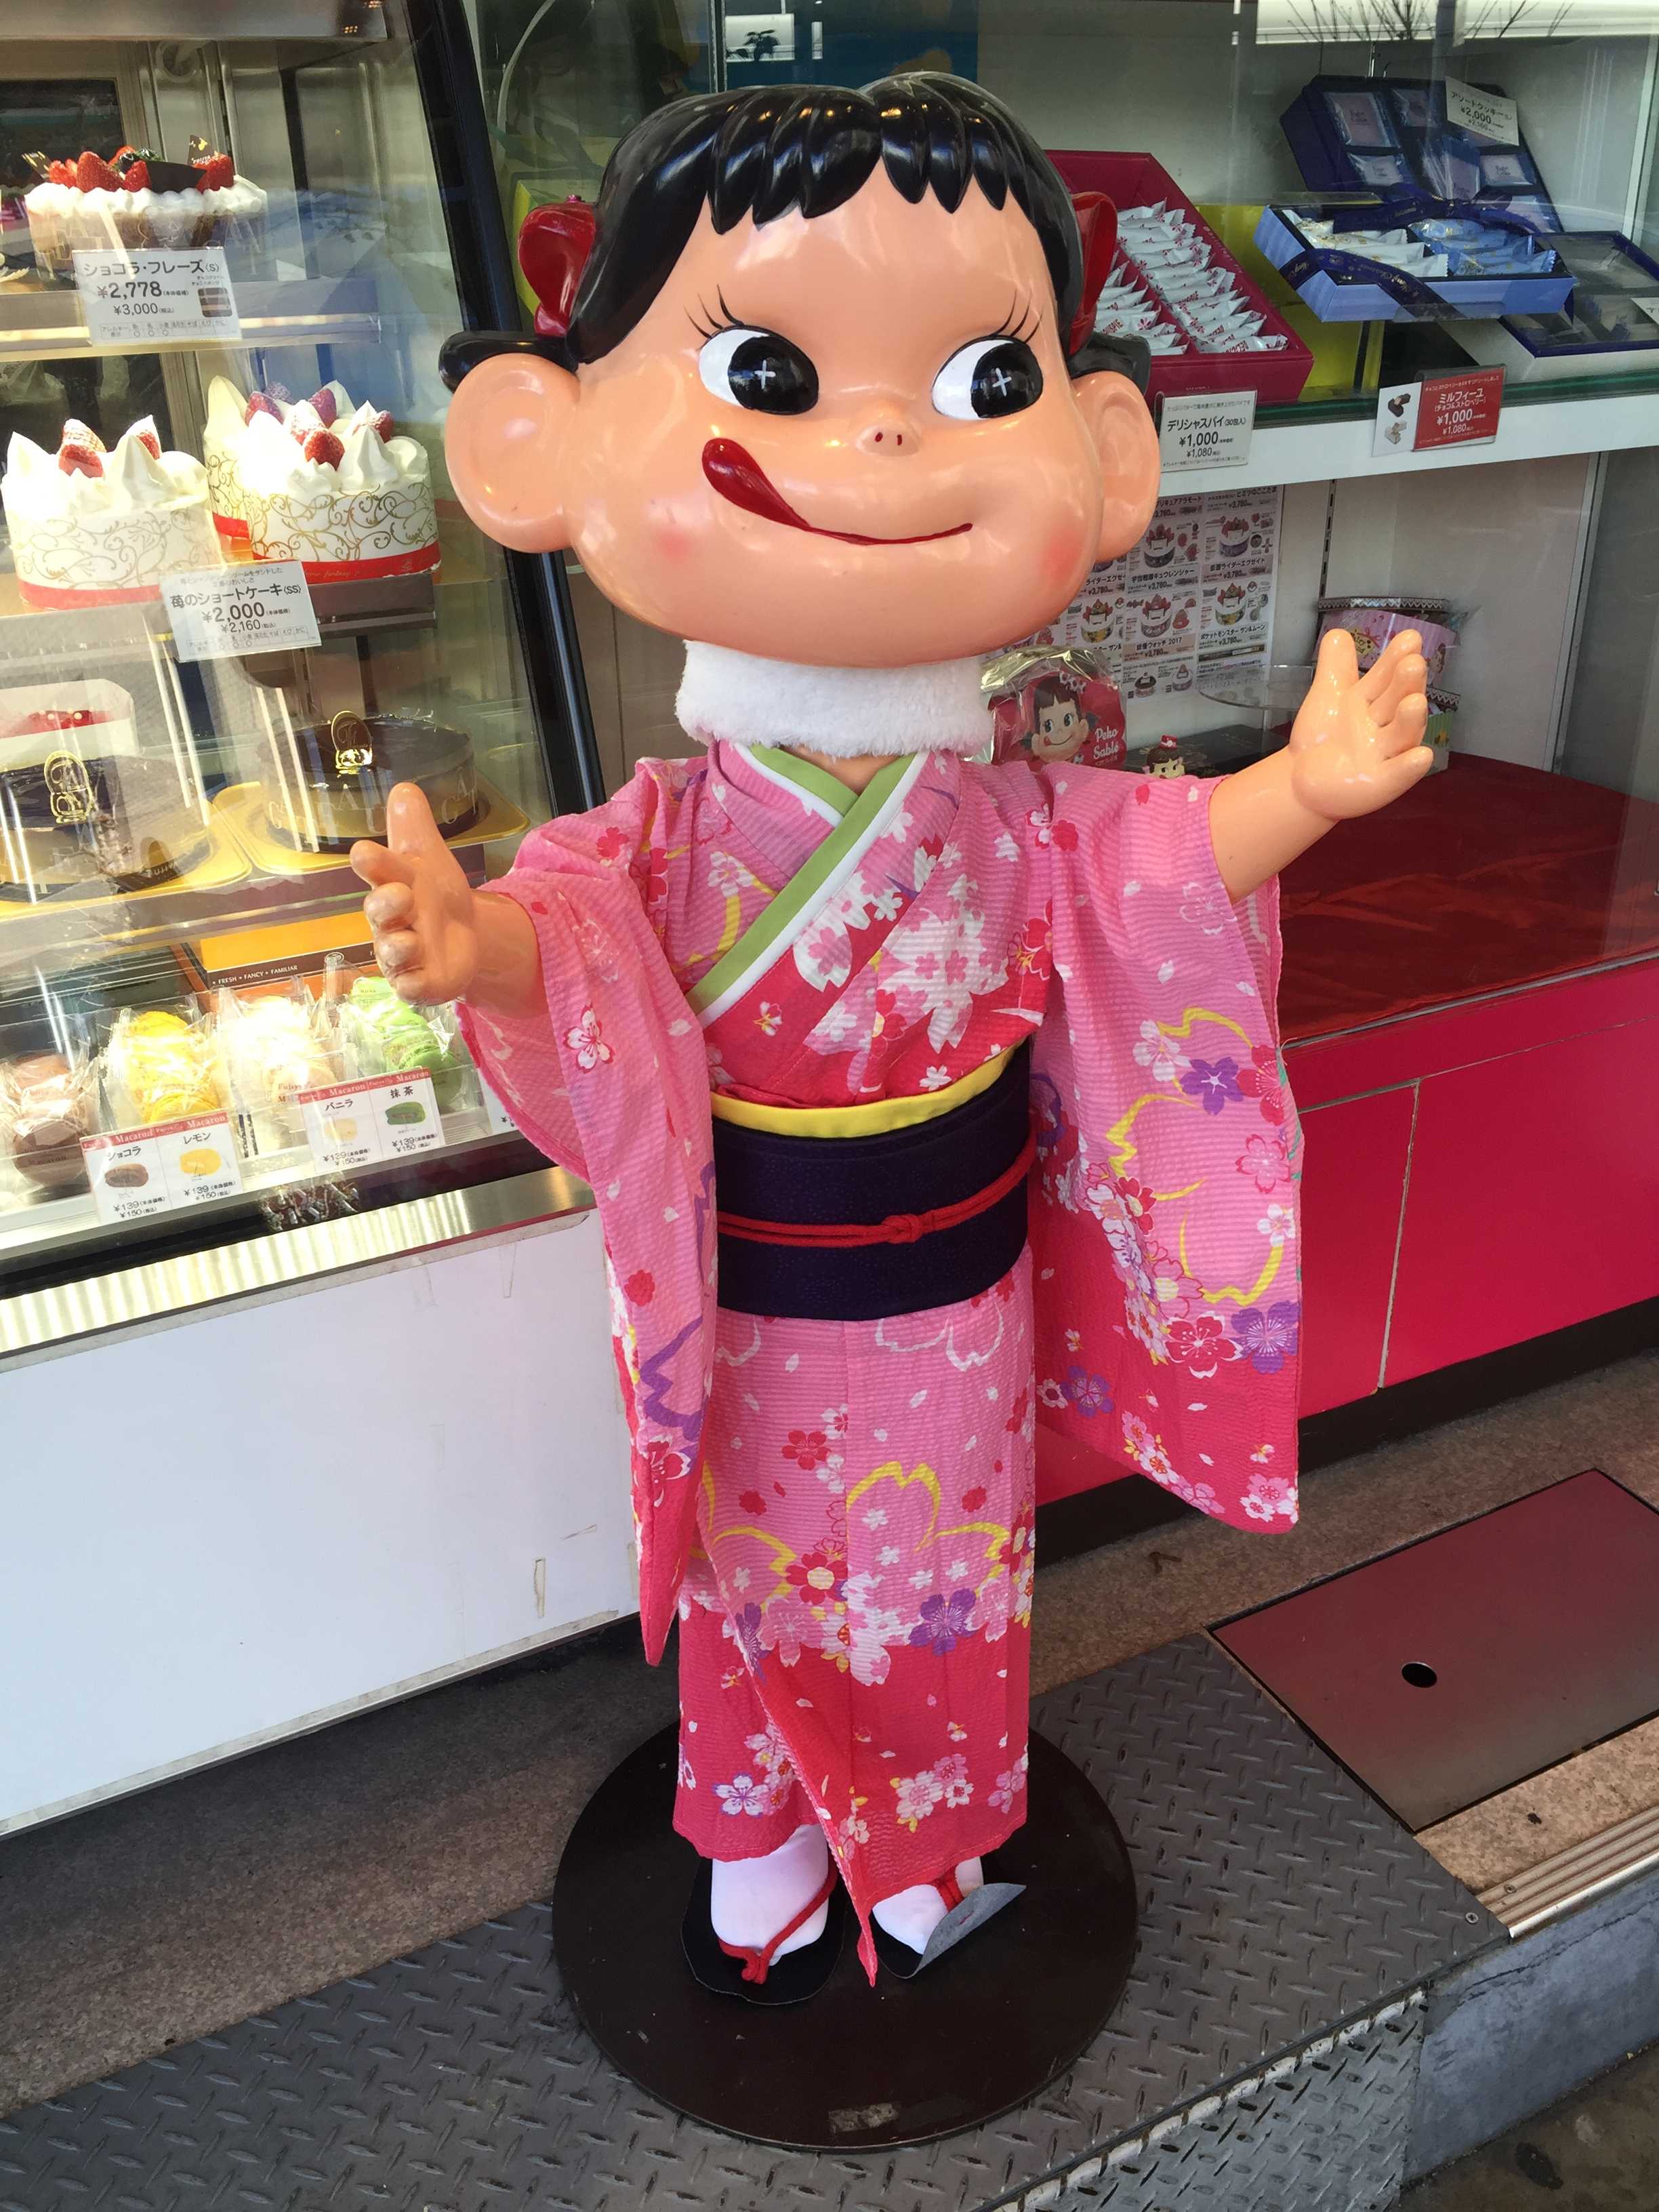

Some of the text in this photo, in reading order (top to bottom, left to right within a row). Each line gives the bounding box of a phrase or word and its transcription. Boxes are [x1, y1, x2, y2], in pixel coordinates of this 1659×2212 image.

[98, 281, 162, 300] ¥2,778
[113, 303, 158, 316] ¥3,000
[1437, 409, 1473, 426] ¥1,000
[1179, 431, 1218, 447] ¥1,000
[202, 602, 265, 623] ¥2,000
[221, 619, 261, 634] ¥2,160
[1094, 726, 1118, 743] Peko
[218, 965, 298, 985] FRESH FANCY FAMILIAR
[396, 1071, 429, 1083] Macaron
[329, 1083, 366, 1097] Macaron
[186, 1115, 226, 1128] Macaron
[115, 1129, 153, 1144] Macaron
[183, 1132, 211, 1145] レモン
